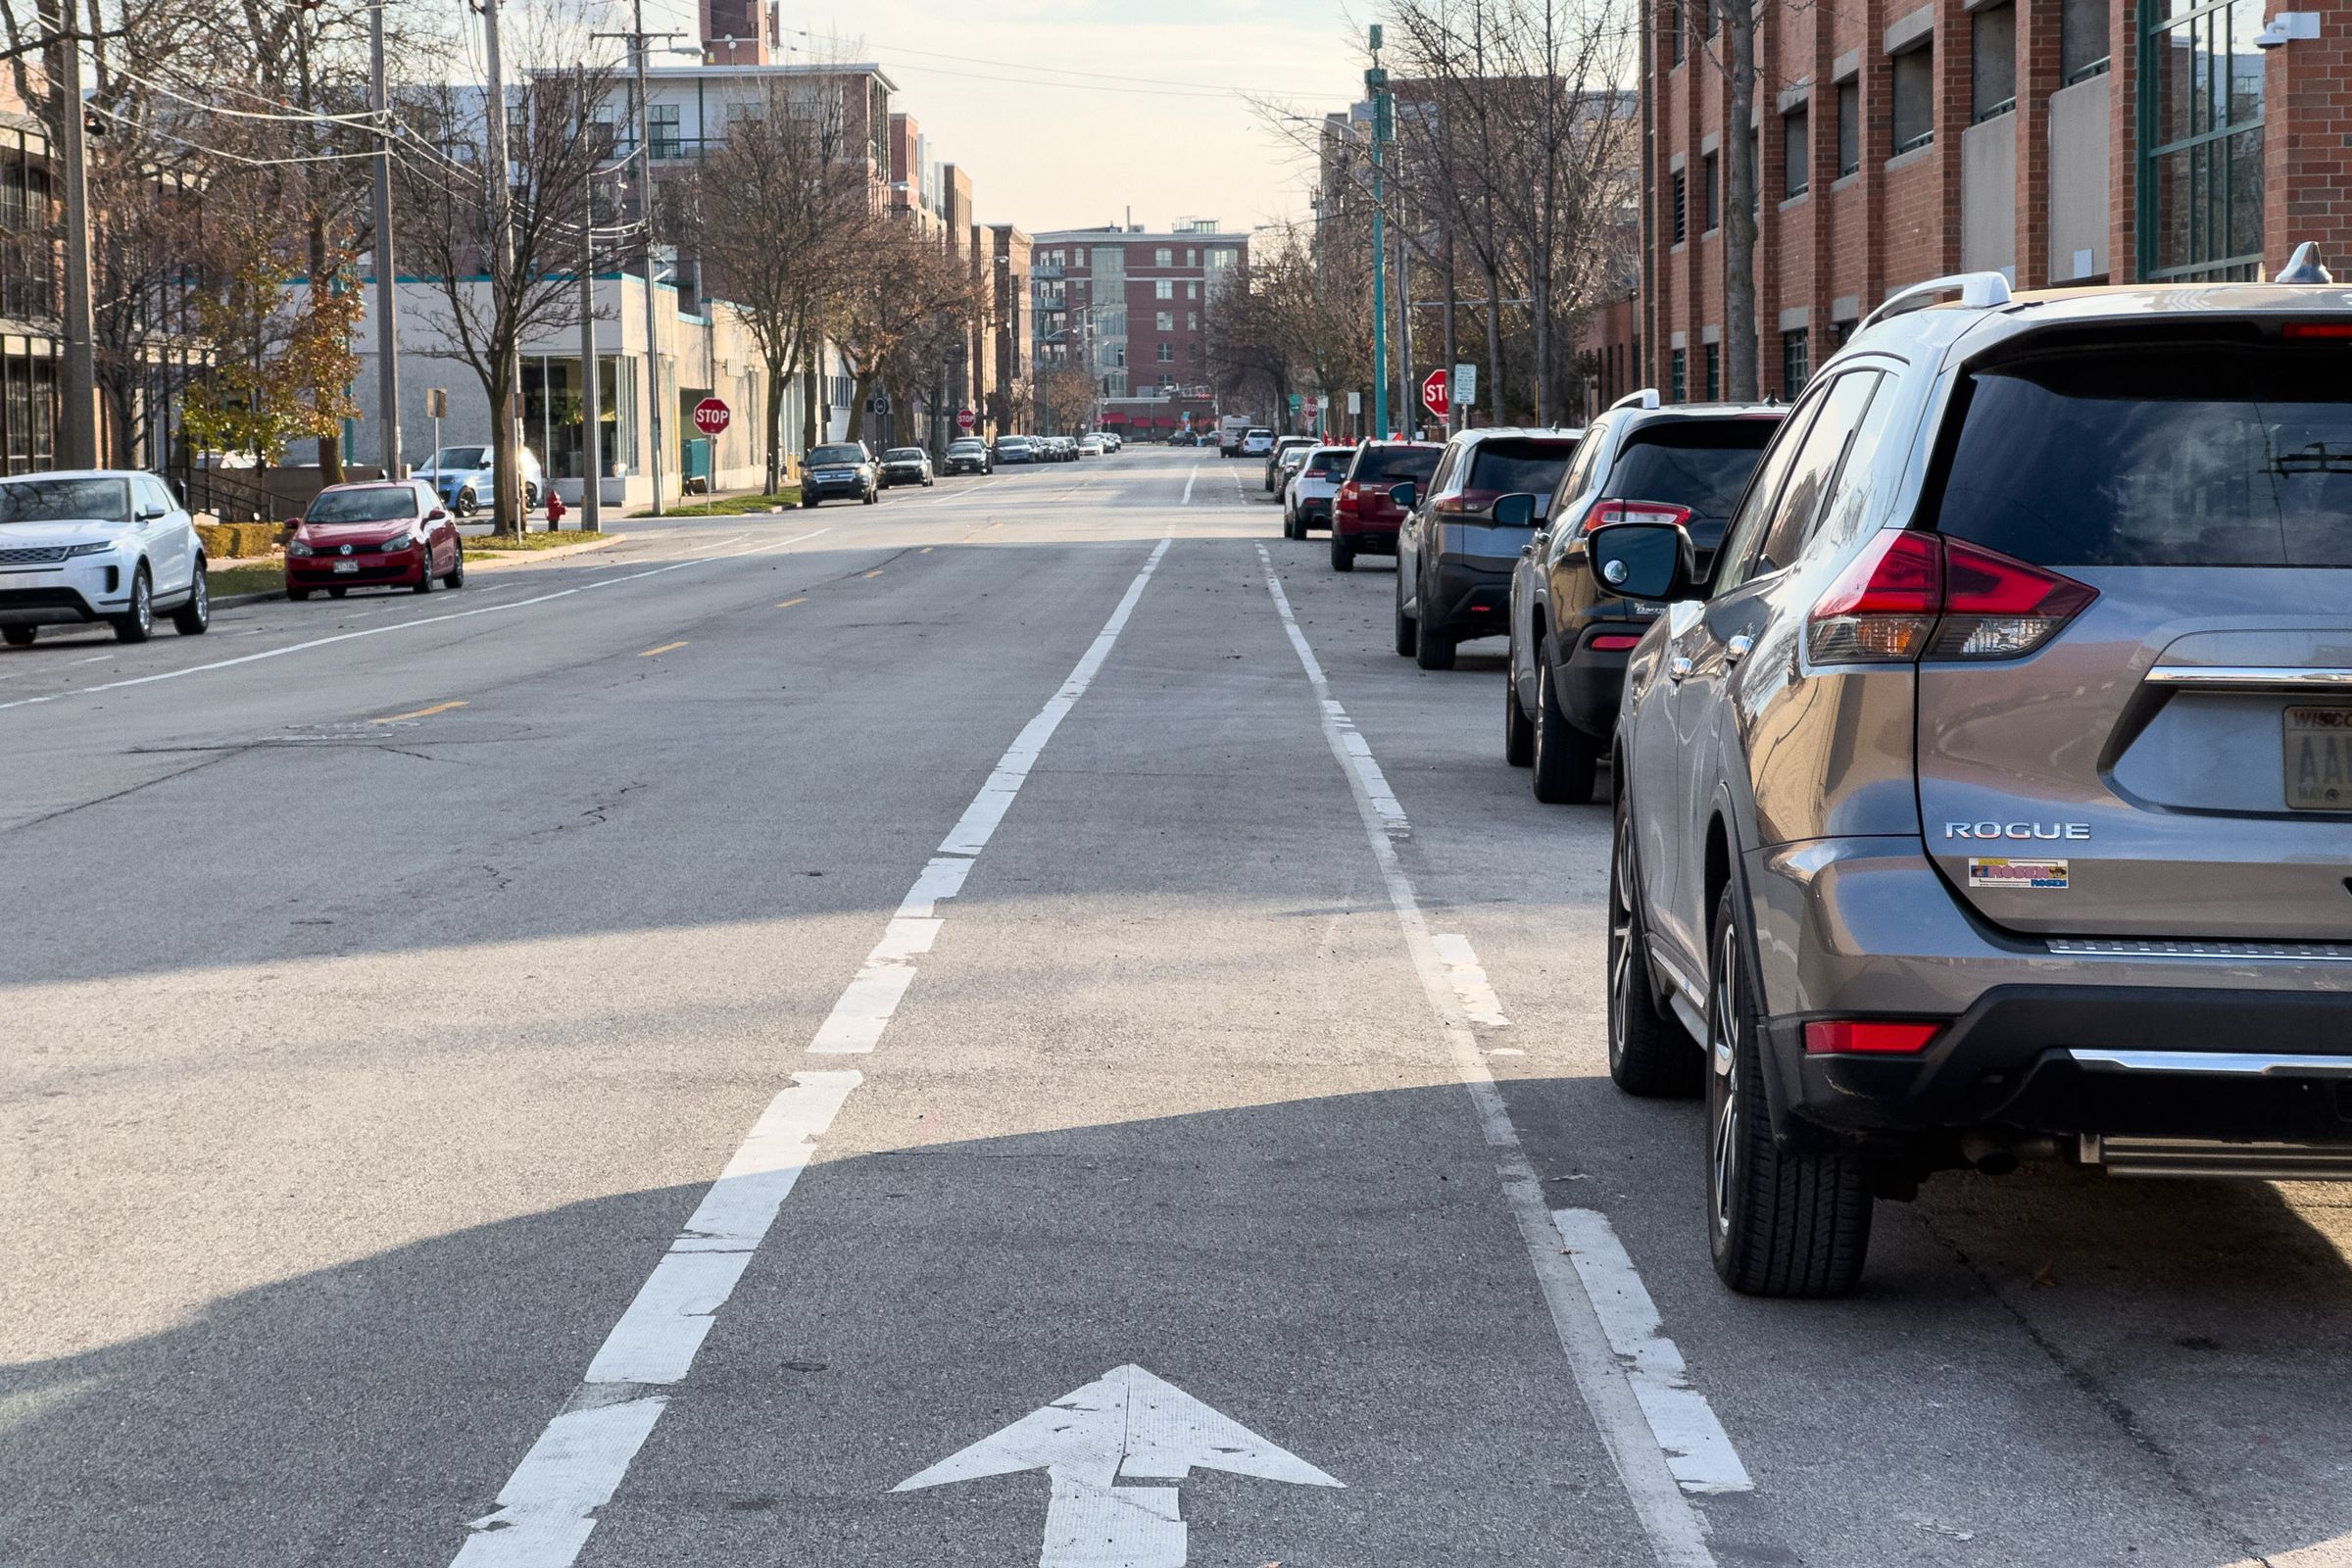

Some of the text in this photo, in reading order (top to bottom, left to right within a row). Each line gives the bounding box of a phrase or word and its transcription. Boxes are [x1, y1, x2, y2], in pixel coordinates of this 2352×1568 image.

[1427, 384, 1448, 402] ST
[696, 409, 729, 423] STOP
[956, 415, 974, 423] STOP
[1945, 821, 2091, 840] ROGUE
[1987, 865, 2049, 879] ROSEN
